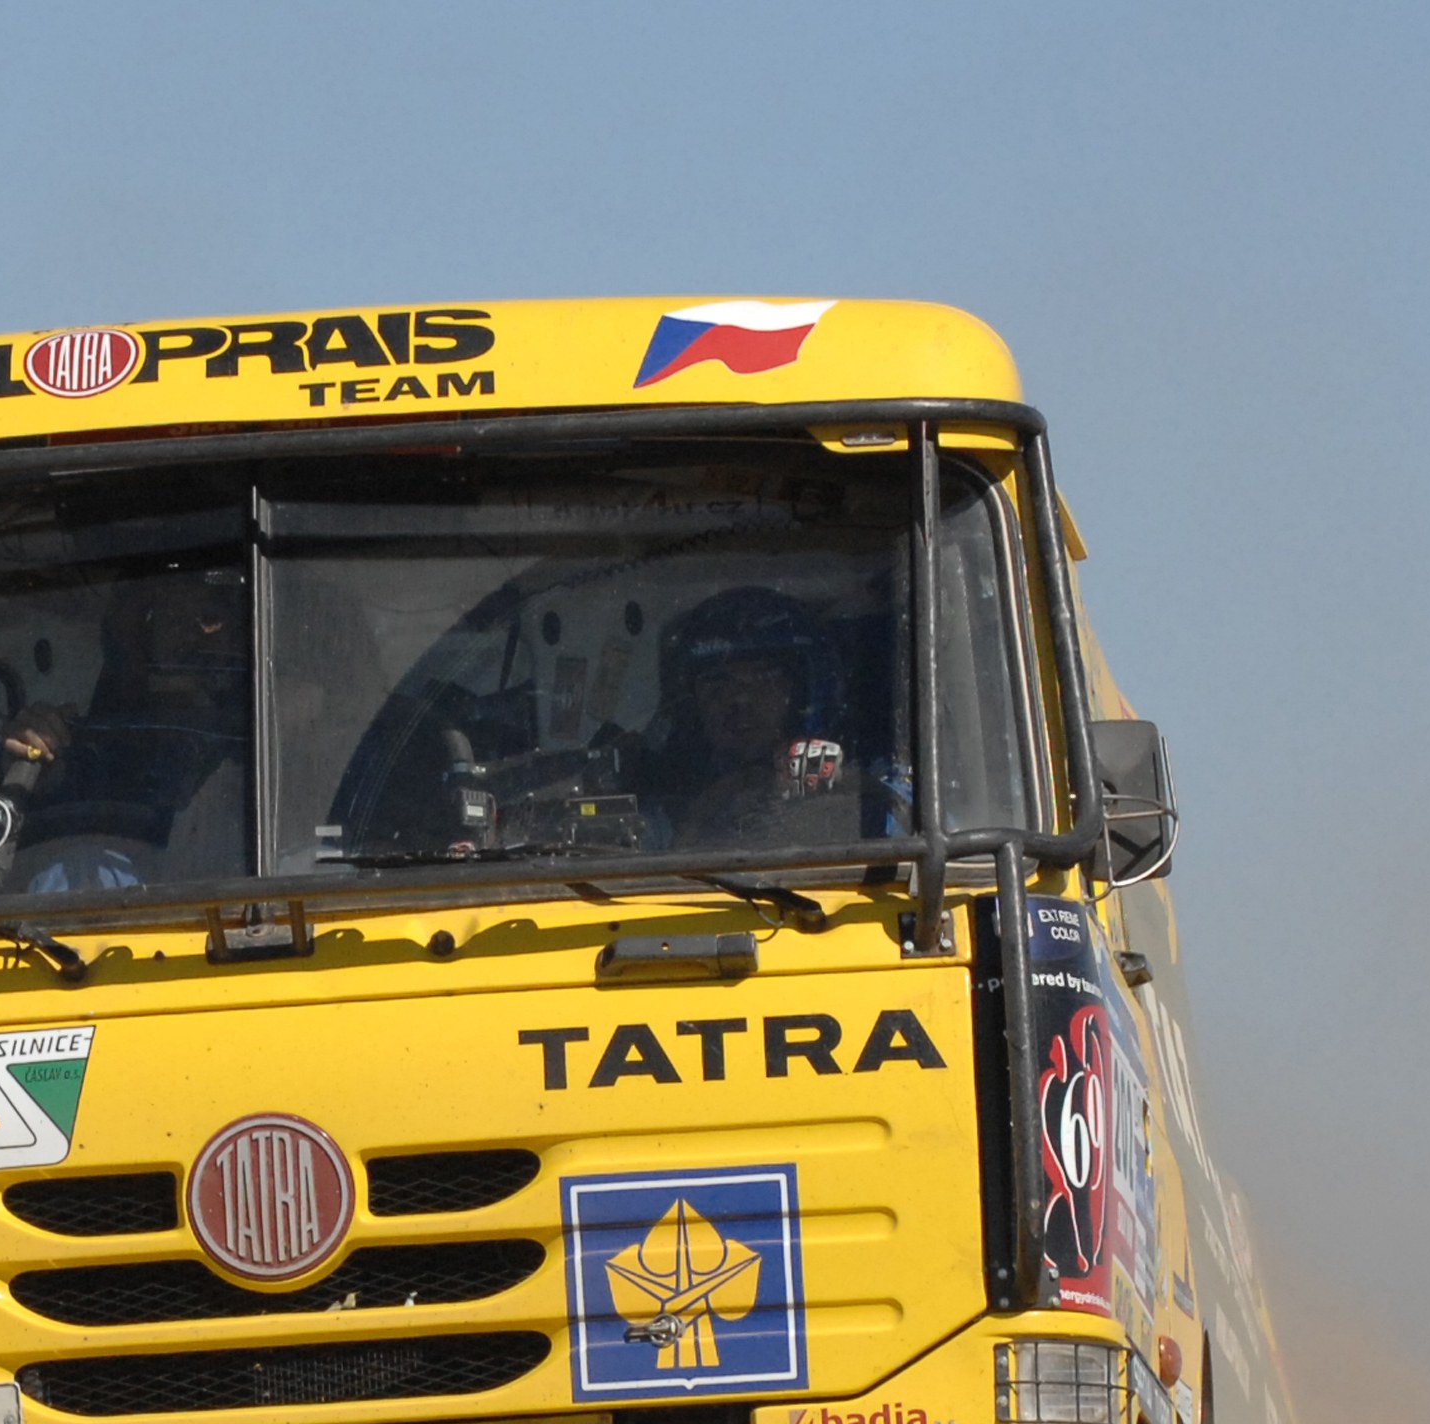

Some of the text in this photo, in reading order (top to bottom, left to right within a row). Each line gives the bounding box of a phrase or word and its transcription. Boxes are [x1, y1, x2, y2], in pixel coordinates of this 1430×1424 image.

[299, 371, 495, 407] TEAM
[1038, 908, 1080, 927] EXTREME
[1051, 926, 1081, 943] COLOR
[1066, 972, 1081, 993] by
[517, 1008, 947, 1091] TATRA
[214, 1130, 320, 1264] TATRA
